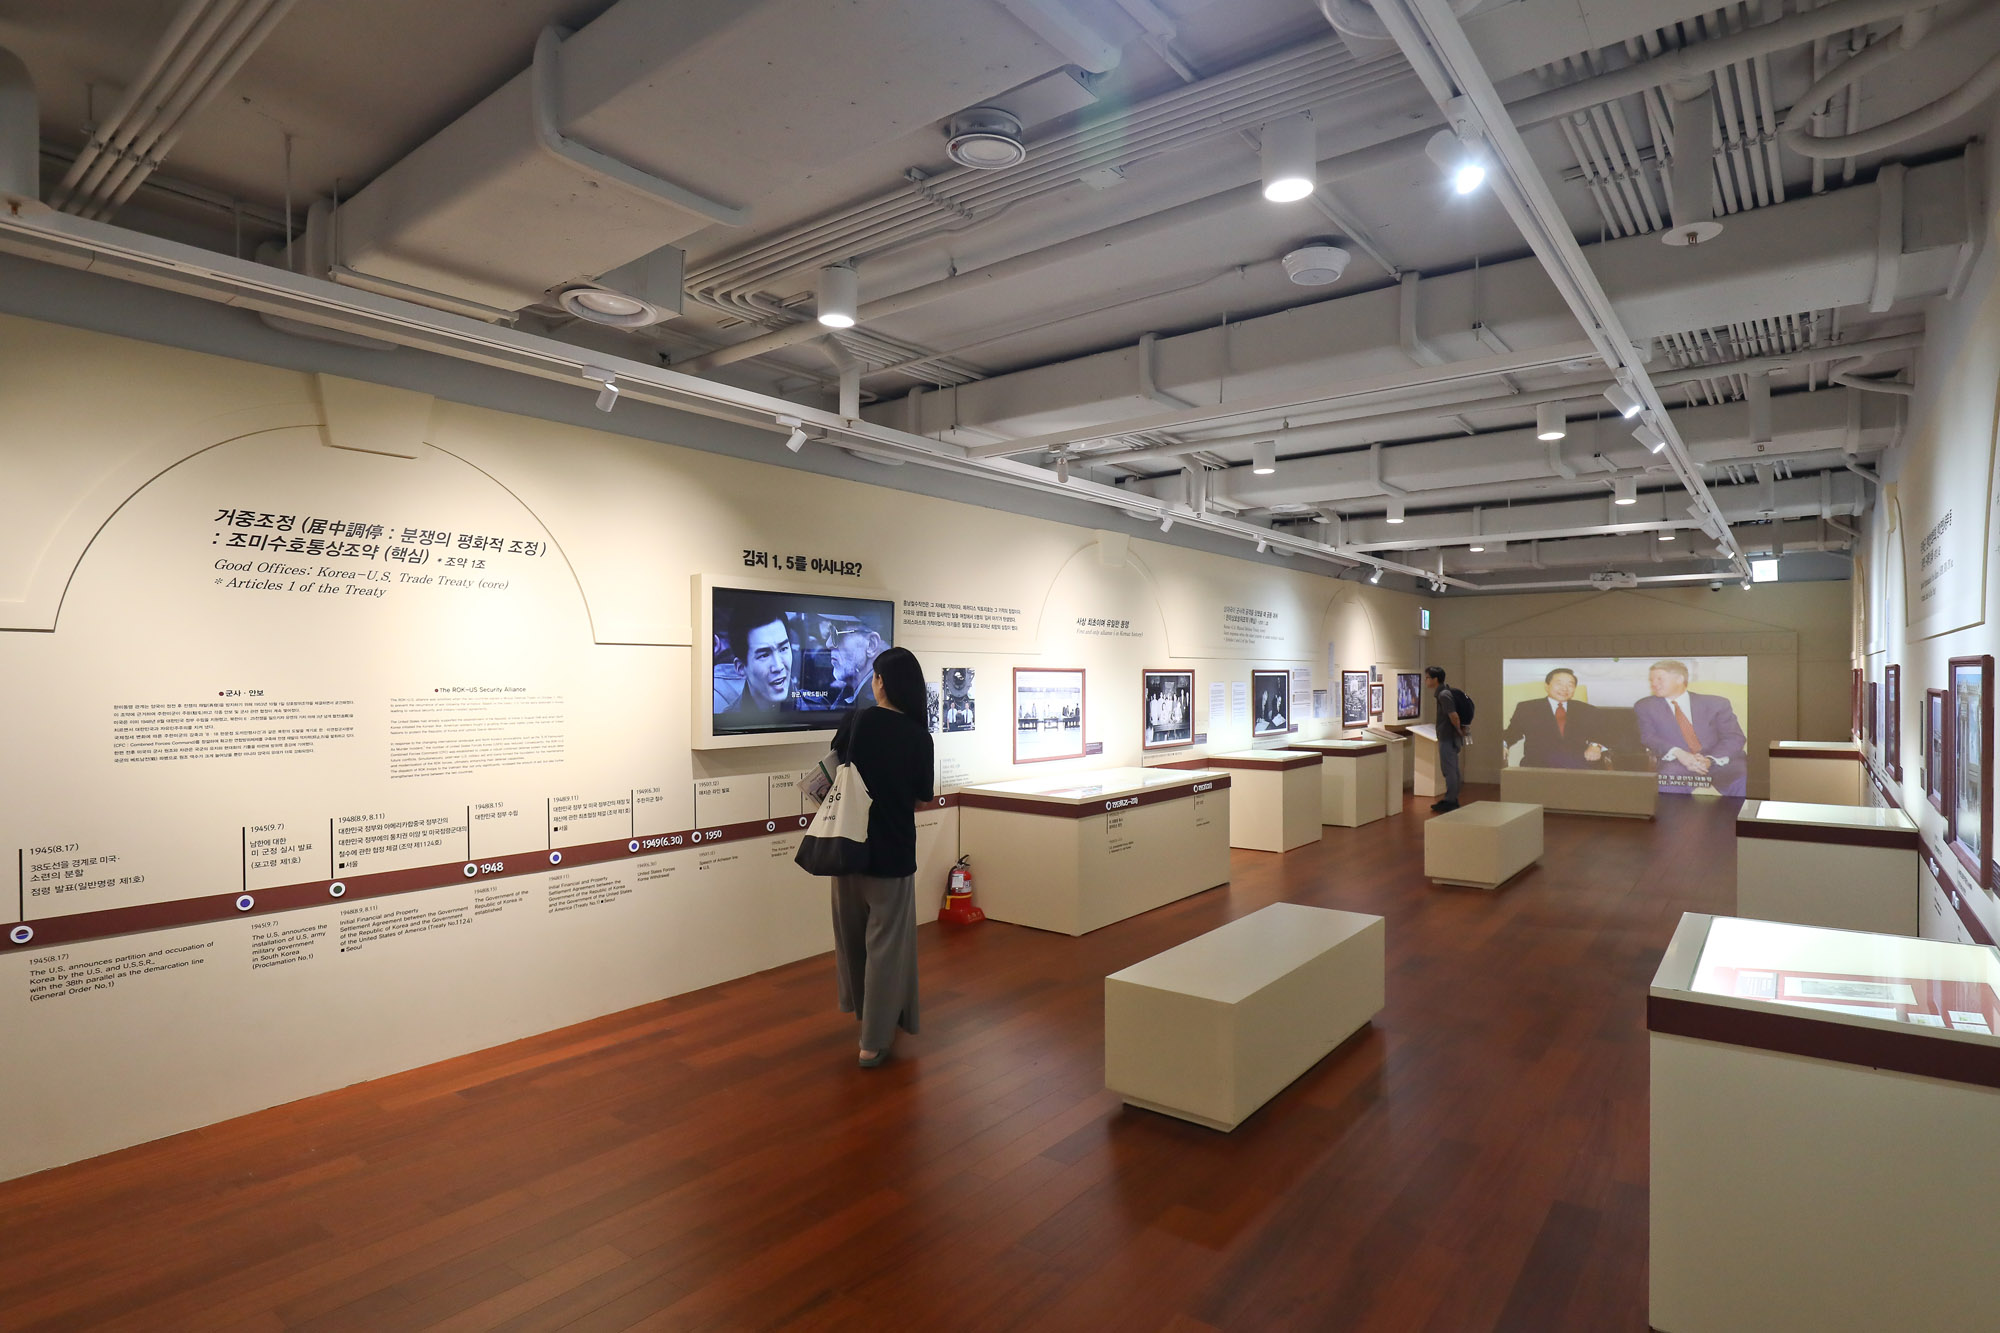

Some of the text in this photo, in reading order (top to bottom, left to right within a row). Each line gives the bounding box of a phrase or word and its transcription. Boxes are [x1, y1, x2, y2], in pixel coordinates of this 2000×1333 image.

[215, 508, 546, 557] 거중조정 (居中調停 분쟁의 평화적 조정)
[226, 532, 486, 569] 조미수호통상조약 (핵심) 조약 1조
[743, 549, 862, 577] 김치 1, 5를 아시나요?
[214, 559, 252, 572] Good
[257, 562, 313, 575] Offices:
[400, 573, 433, 584] Trade
[438, 575, 474, 588] Treaty
[479, 578, 509, 590] (core)
[226, 577, 386, 598] Articles 1 of the Treaty
[226, 689, 264, 697] 군사 안보
[251, 823, 284, 832] 1945(9.7)
[339, 817, 448, 834] 대한민국 정부와 아메리카합중국 정부간의
[339, 837, 363, 846] 대한민국
[642, 834, 683, 849] 1949(6.30)
[705, 830, 722, 840] 1950
[30, 843, 79, 855] 1945(8.17)
[250, 839, 270, 848] 남한에
[31, 860, 69, 872] 38도선을
[72, 858, 97, 868] 경계로
[281, 857, 301, 865] 제1호)
[480, 862, 504, 874] 1948
[30, 869, 83, 882] 소련의 분할
[55, 879, 115, 894] 발표(일반명령
[119, 875, 144, 885] 제1호)
[340, 924, 370, 932] Settlement
[372, 918, 402, 927] Agreement
[404, 913, 426, 921] between
[438, 906, 468, 915] Government
[357, 914, 382, 922] Financial
[396, 908, 418, 916] Property
[282, 926, 315, 935] announces
[359, 928, 383, 936] Republic
[432, 913, 463, 922] Government
[405, 926, 427, 934] America
[252, 938, 286, 947] installation
[277, 940, 314, 951] government
[29, 953, 69, 965] 1945(8.17)
[49, 966, 65, 974] U.S.
[69, 958, 113, 971] announces
[115, 952, 146, 963] partition
[149, 949, 162, 957] and
[165, 944, 204, 956] occupation
[252, 958, 296, 970] (Proclamation
[30, 976, 55, 985] Korea
[58, 973, 68, 981] by
[72, 970, 83, 978] the
[87, 966, 103, 975] U.S.
[106, 964, 120, 972] and
[30, 985, 47, 993] with
[50, 982, 62, 990] the
[66, 979, 83, 987] 38th
[86, 974, 114, 984] parallel
[144, 960, 188, 973] demarcation
[30, 981, 114, 1002] (General Order No.1)
